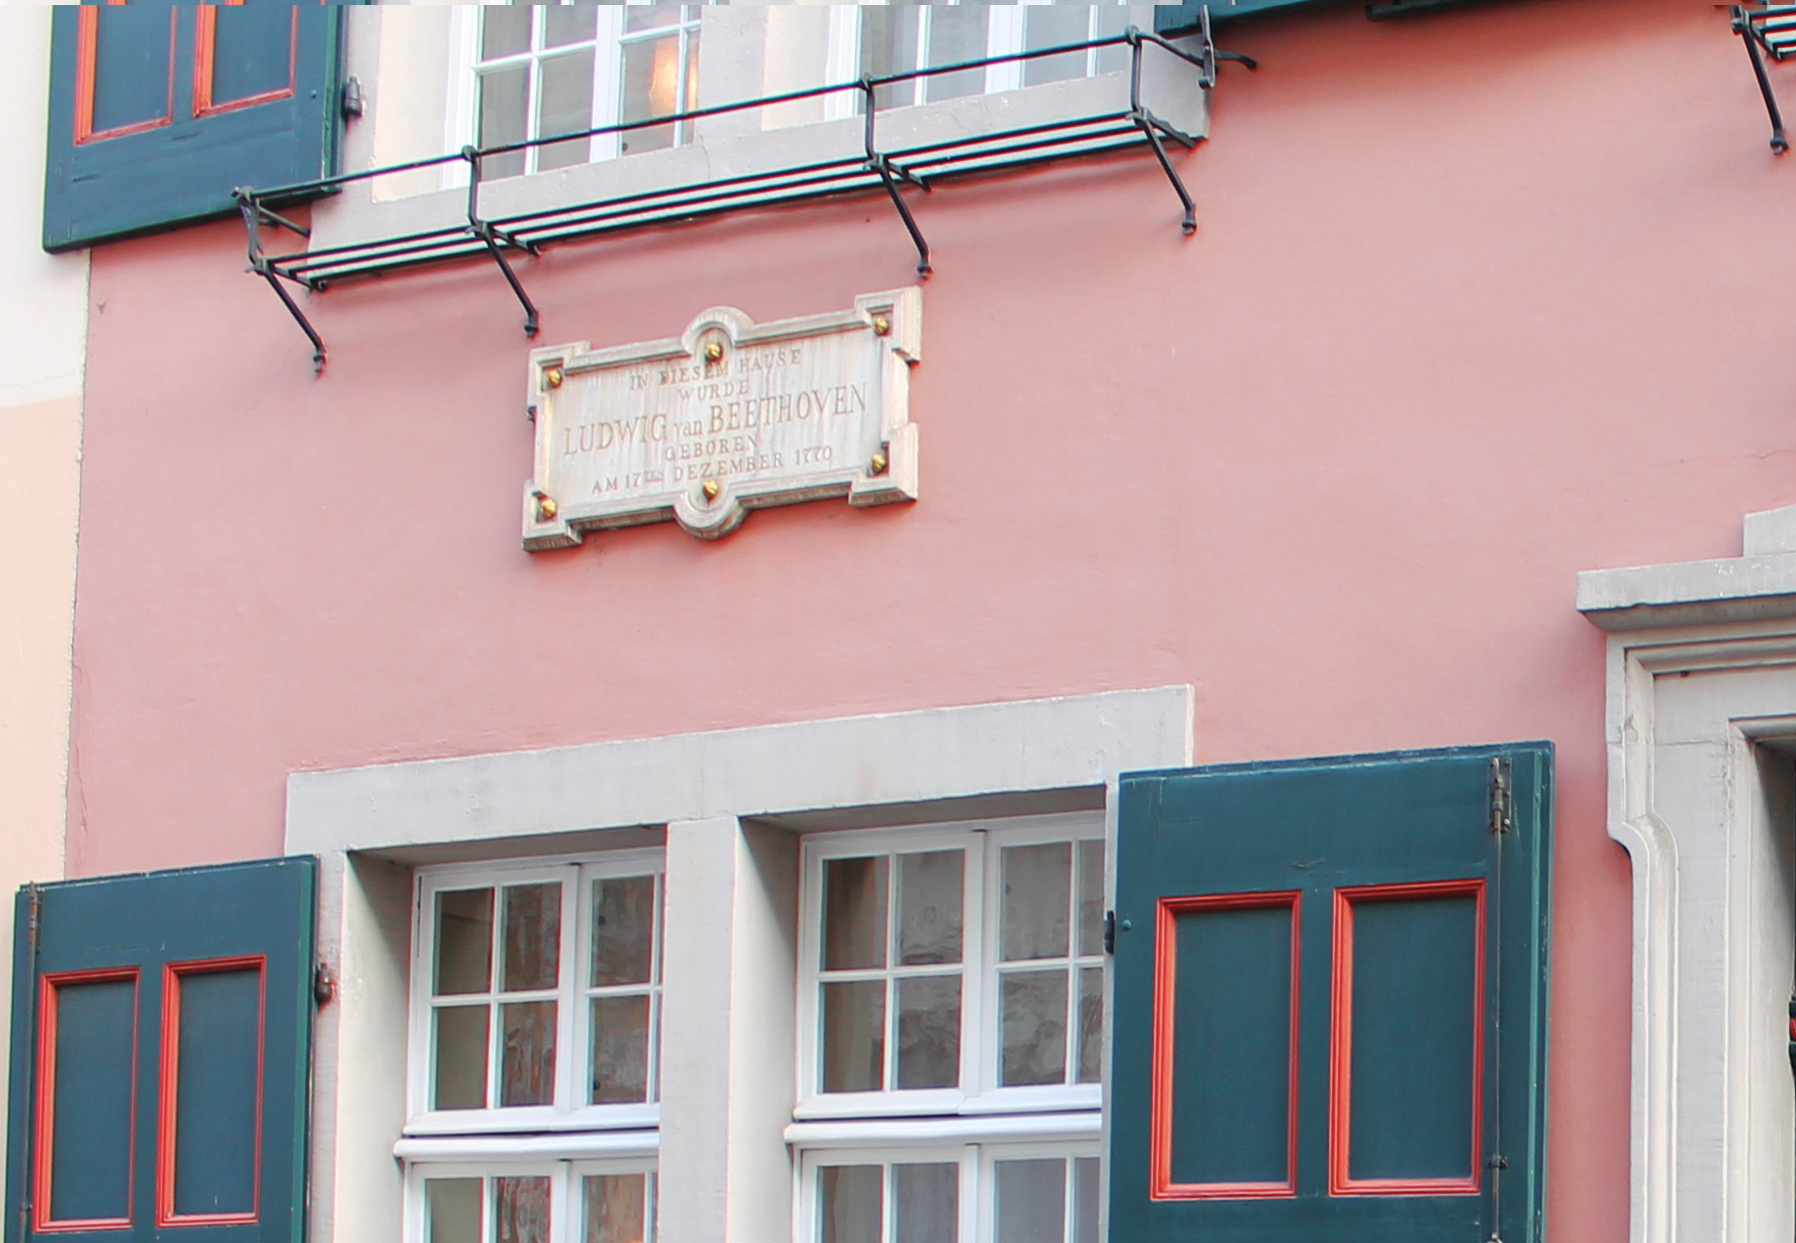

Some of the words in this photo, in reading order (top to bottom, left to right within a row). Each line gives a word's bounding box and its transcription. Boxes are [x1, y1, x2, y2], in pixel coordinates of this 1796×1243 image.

[630, 374, 649, 391] IN
[659, 361, 729, 386] DIESEM
[739, 349, 801, 374] HAUSE
[679, 380, 749, 401] WURDE
[564, 413, 668, 456] LUDWIG
[673, 419, 703, 437] van
[708, 382, 867, 434] BEETHOVEN
[665, 434, 758, 461] GEBOREN
[592, 476, 618, 495] AM
[673, 452, 784, 482] DEZEMBER
[795, 445, 833, 465] 1770
